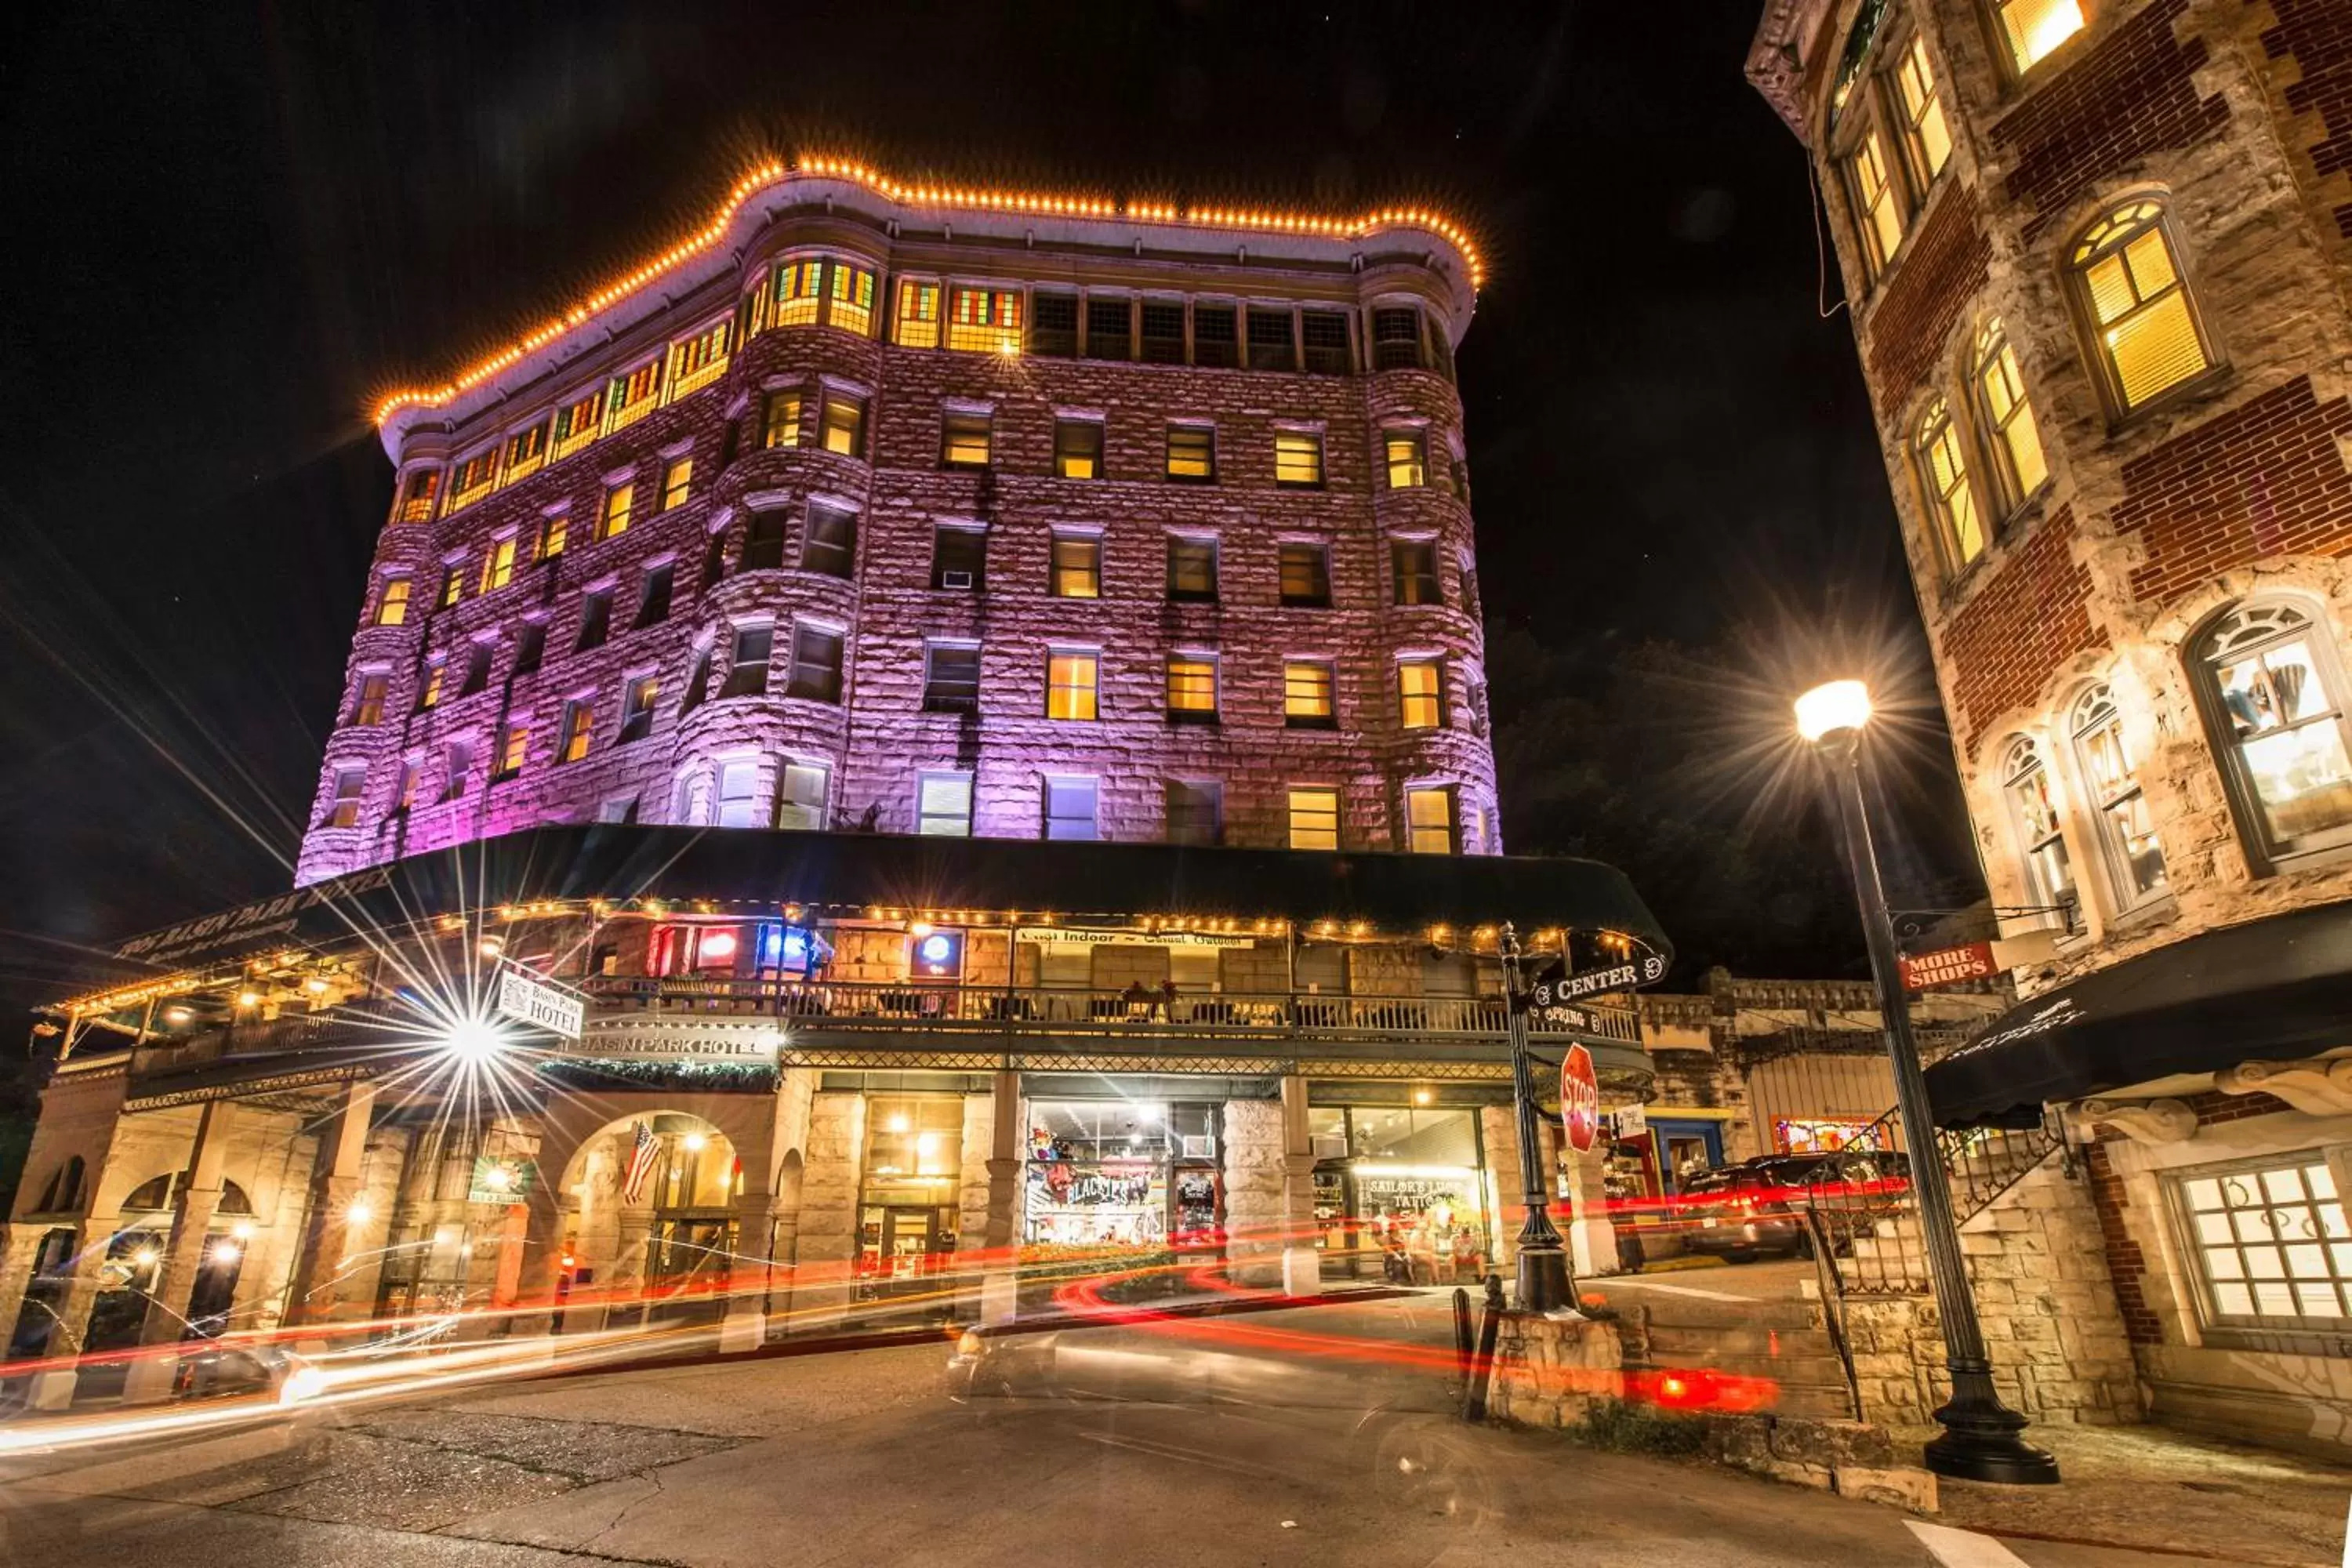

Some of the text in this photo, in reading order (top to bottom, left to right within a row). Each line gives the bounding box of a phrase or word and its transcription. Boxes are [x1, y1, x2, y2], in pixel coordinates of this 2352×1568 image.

[228, 891, 306, 928] PARK
[300, 865, 396, 910] HOTEL
[1064, 931, 1116, 942] Indoor
[1908, 960, 1987, 988] SHOPS
[1909, 948, 1975, 973] MORE
[1557, 964, 1638, 1000] CENTER
[530, 1000, 577, 1033] HOTEL
[1545, 1007, 1585, 1027] SPRING
[640, 1037, 694, 1053] PARK
[699, 1040, 764, 1054] HOTEL
[1564, 1073, 1596, 1111] STOP
